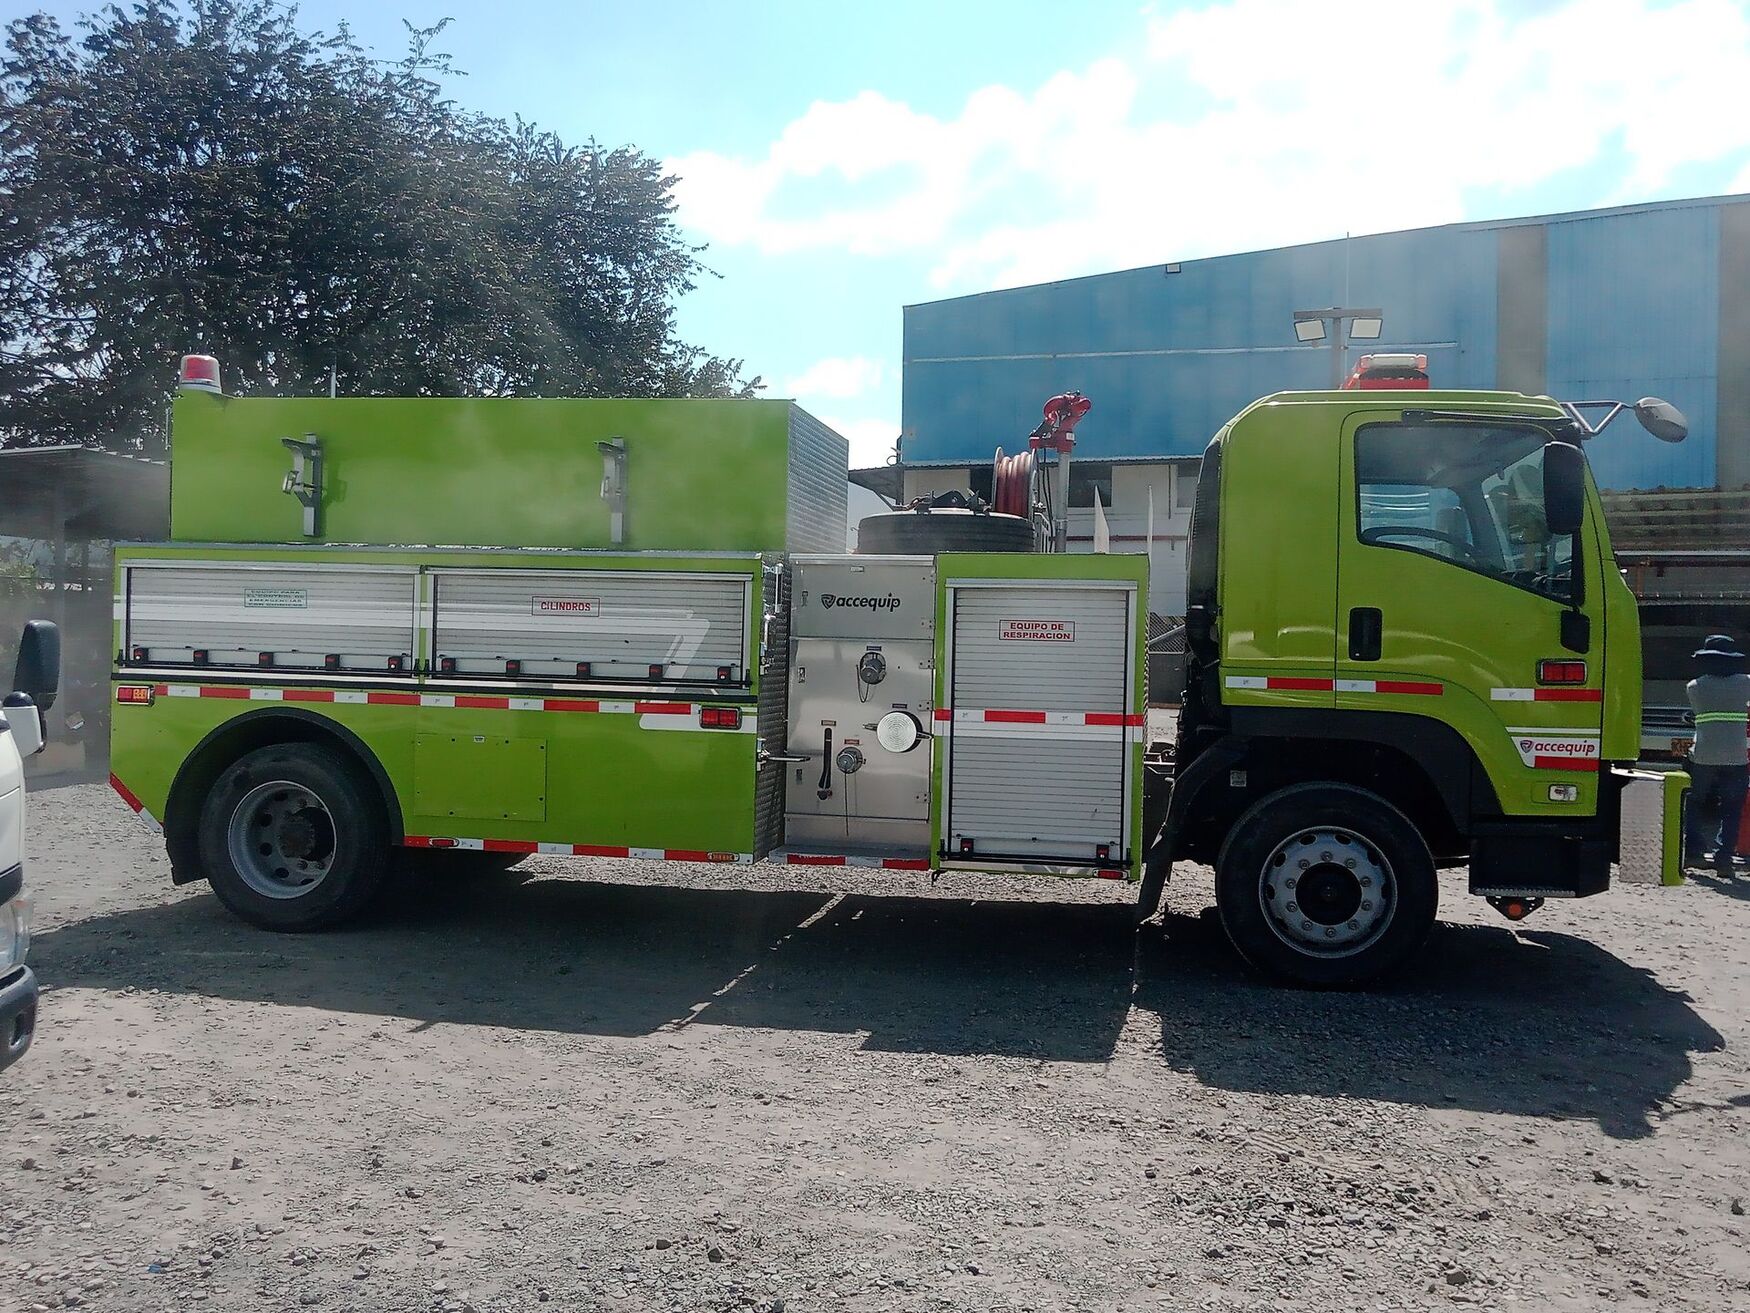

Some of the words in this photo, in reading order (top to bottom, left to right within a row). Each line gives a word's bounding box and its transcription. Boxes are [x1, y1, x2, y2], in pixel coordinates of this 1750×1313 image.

[541, 601, 591, 611] CILINDROS
[836, 592, 901, 612] accequip
[1010, 622, 1048, 630] EQUIPO
[1051, 623, 1065, 631] DE
[1003, 631, 1071, 639] RESPIRACION
[1534, 740, 1595, 756] accequip
